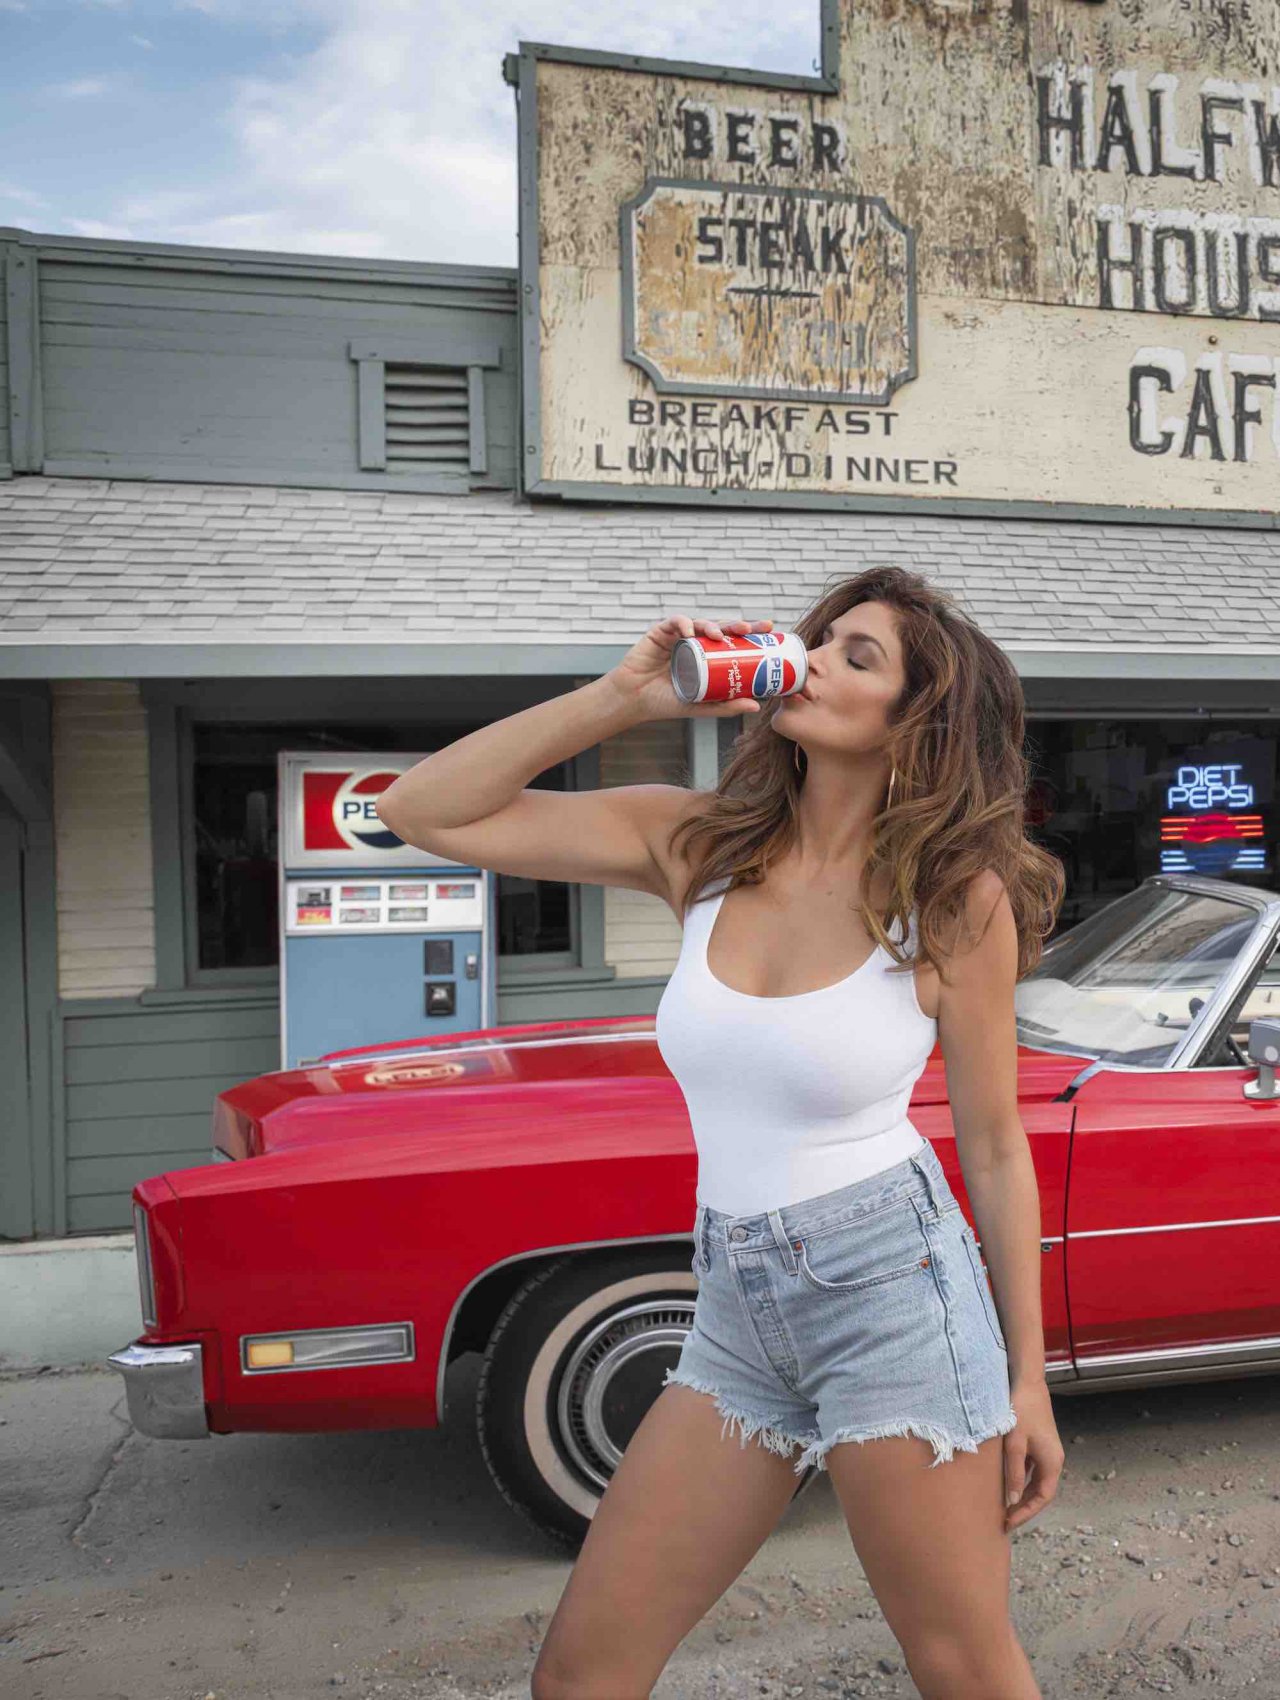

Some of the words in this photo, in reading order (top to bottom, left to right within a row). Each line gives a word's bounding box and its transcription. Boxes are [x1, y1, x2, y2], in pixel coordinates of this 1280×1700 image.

[683, 106, 843, 174] BEER
[697, 217, 850, 275] STEAK
[628, 398, 900, 438] BREAKFAST
[767, 657, 781, 696] PEPS
[1178, 764, 1242, 788] DIET
[1167, 784, 1254, 809] PEPSI
